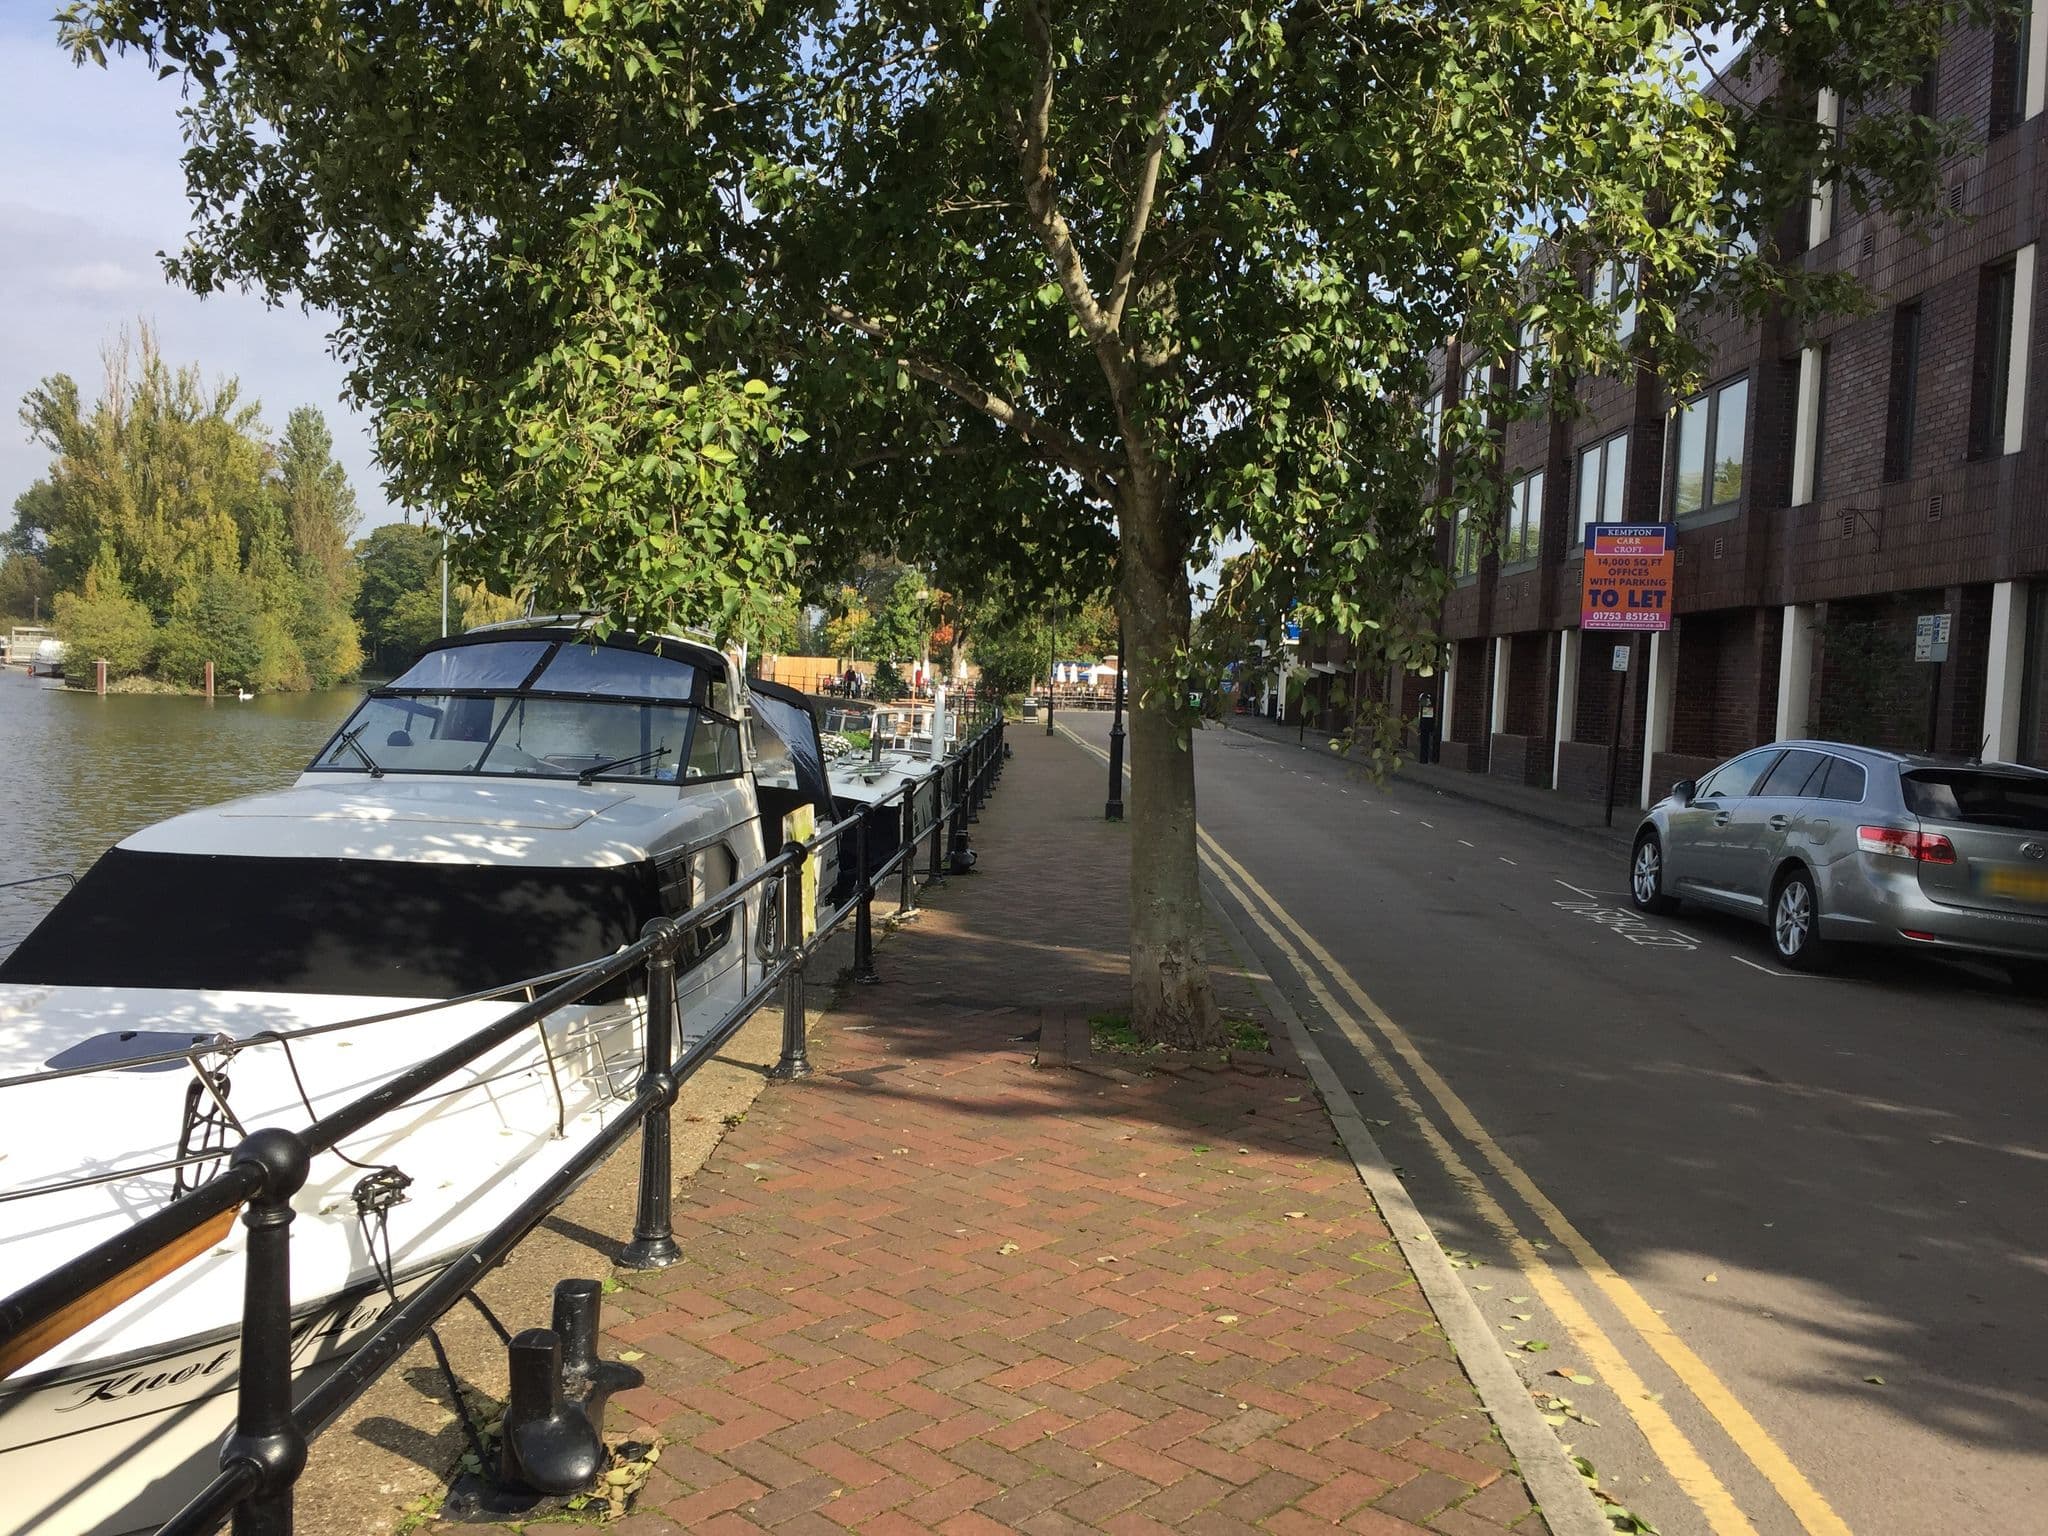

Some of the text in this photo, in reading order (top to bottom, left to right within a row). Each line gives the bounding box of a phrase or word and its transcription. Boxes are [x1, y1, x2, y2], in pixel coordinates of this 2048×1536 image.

[1616, 537, 1641, 545] CARR
[1598, 558, 1630, 567] 14,000
[1651, 558, 1662, 566] FT
[1608, 568, 1649, 576] OFFICES
[1590, 578, 1666, 586] WITH PARKING
[1588, 589, 1666, 608] TO LET
[1593, 611, 1660, 620] 01753 851251
[54, 1348, 237, 1413] Knot
